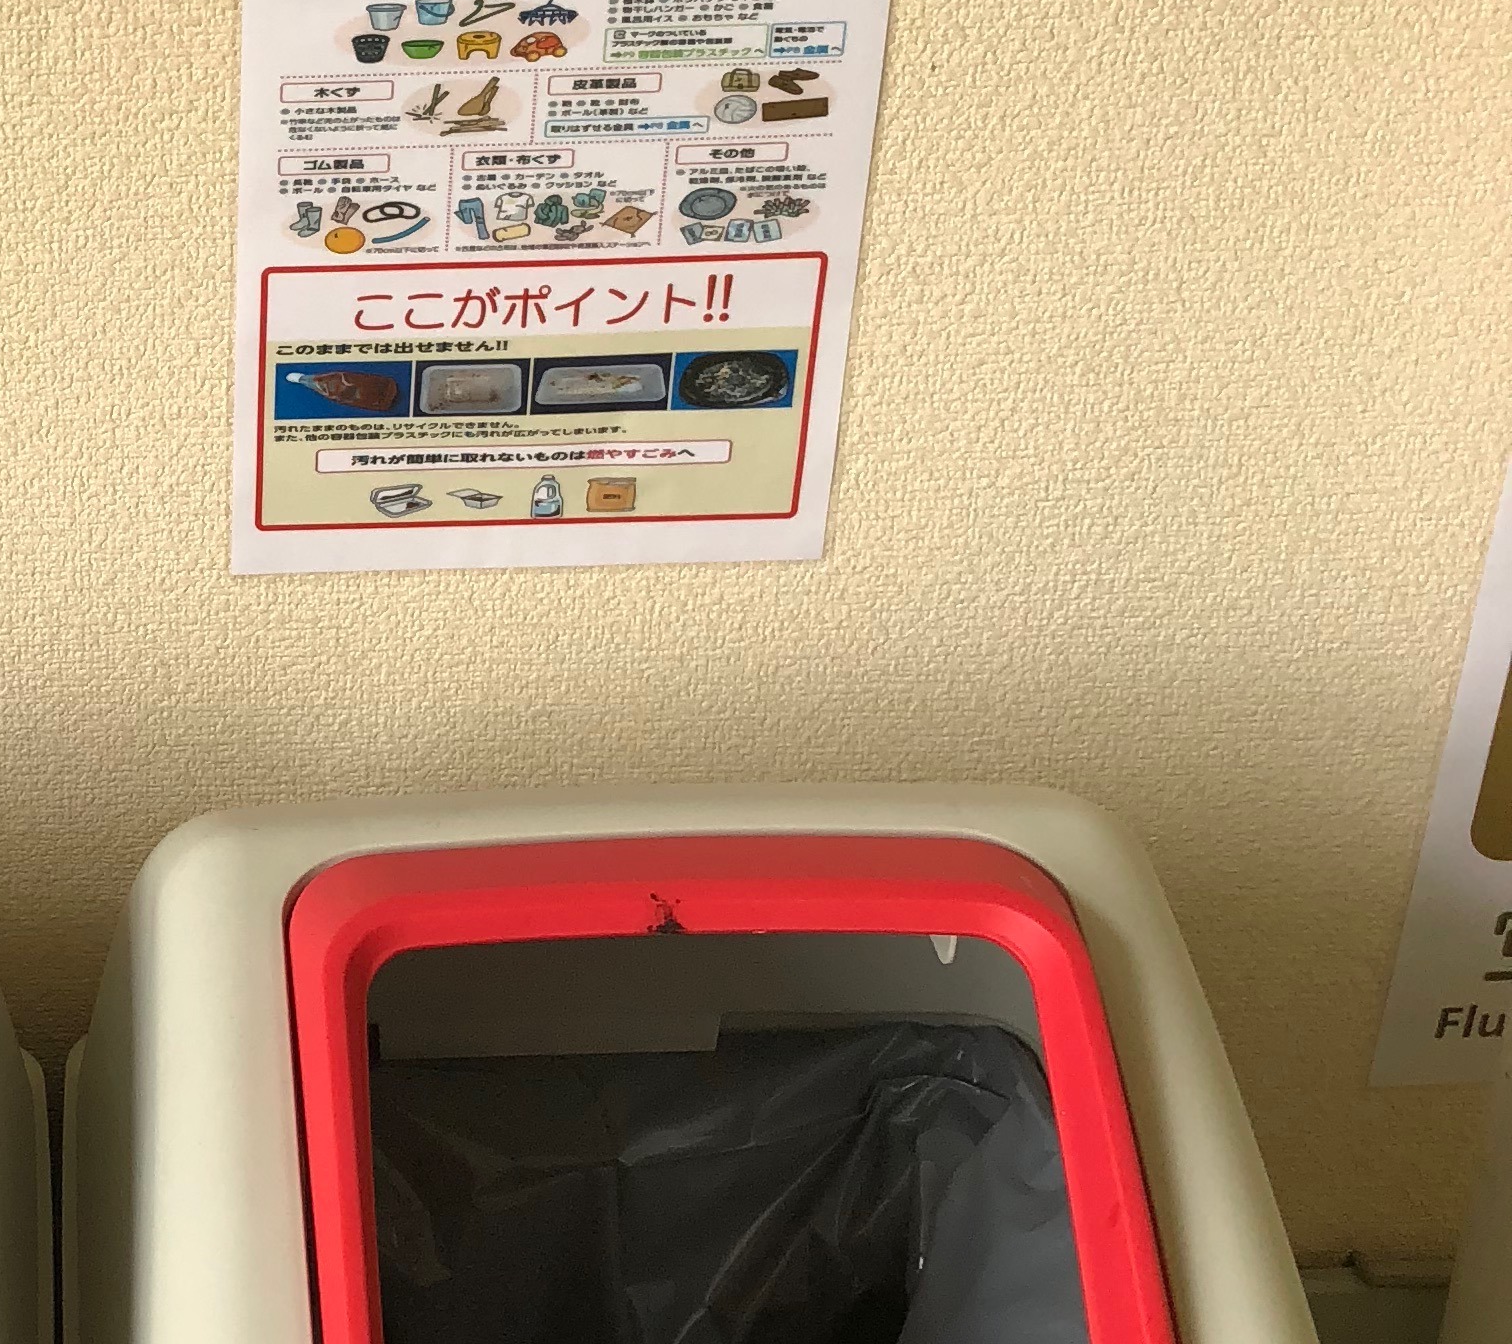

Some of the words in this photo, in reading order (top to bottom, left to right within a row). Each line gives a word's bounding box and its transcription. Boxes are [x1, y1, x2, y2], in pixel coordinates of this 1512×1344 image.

[314, 86, 361, 98] 木くず
[709, 147, 756, 159] その他
[354, 274, 733, 331] ここがポイント!!
[276, 339, 509, 356] このままでは出せません!!
[351, 447, 696, 467] 汚れが簡単に取れないものは燃やすごみへ
[1434, 1003, 1506, 1039] Flu
